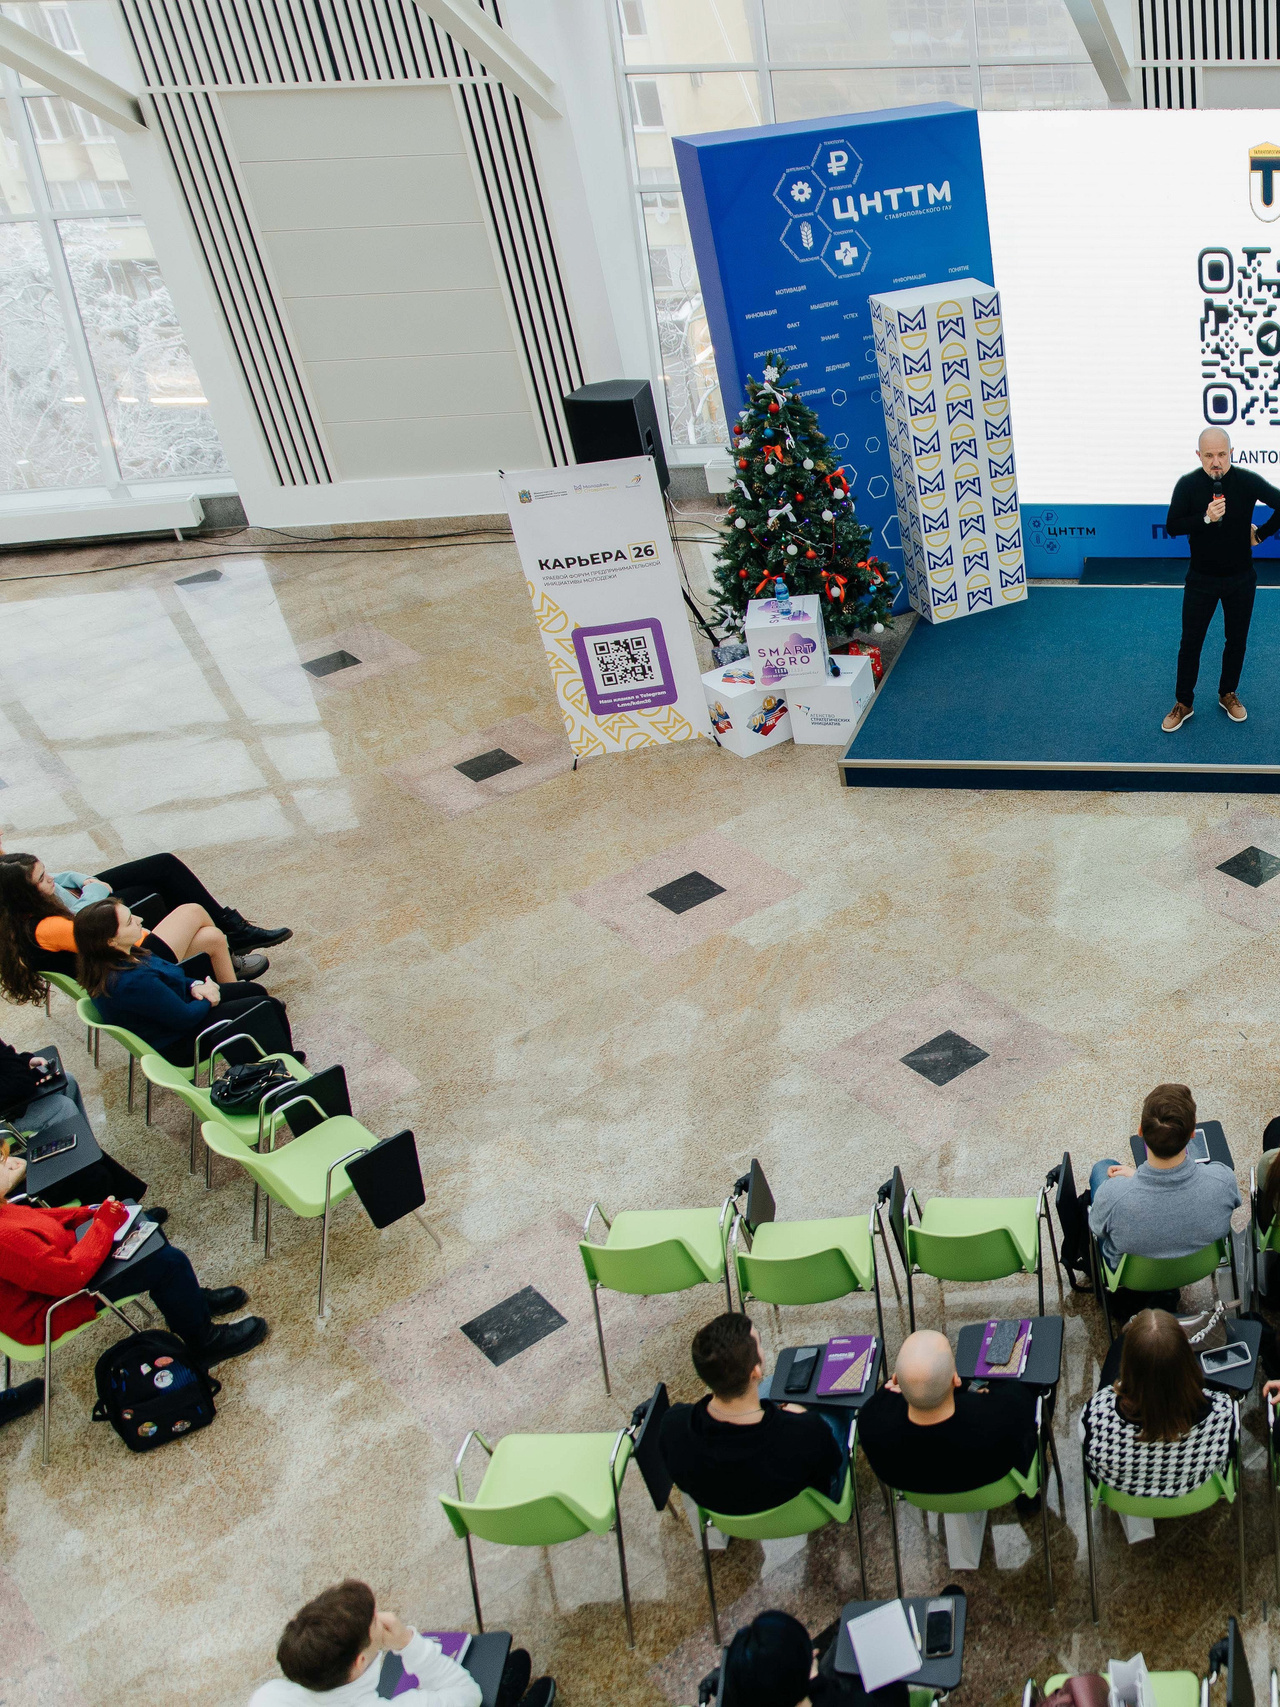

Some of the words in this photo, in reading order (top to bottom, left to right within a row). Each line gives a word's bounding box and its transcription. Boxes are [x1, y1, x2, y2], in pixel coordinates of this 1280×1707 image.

[832, 180, 951, 222] ЦНТТМ
[884, 206, 941, 220] СТАВРОПОЛЬСКОГО
[942, 204, 953, 212] ГАУ
[948, 265, 970, 274] ПОНЯТИЕ
[892, 273, 926, 284] ИНФОРМАЦИЯ
[775, 284, 807, 296] МОТИВАЦИЯ
[810, 300, 839, 310] МЫШЛЕНИЕ
[745, 308, 778, 320] ИННОВАЦИЯ
[842, 312, 858, 320] УСПЕХ
[820, 333, 840, 342] ЗНАНИЕ
[825, 362, 851, 373] ДЕДУКЦИЯ
[858, 372, 880, 382] ГИПОТЕЗ
[1047, 526, 1096, 538] ЦНТТМ
[538, 549, 628, 571] КАРЬЕРА
[632, 544, 655, 559] 26
[542, 573, 568, 581] КРАЕВОЙ
[568, 571, 590, 579] ФОРУМ
[544, 579, 582, 587] ИНИЦИАТИВЫ
[757, 643, 813, 658] SMART
[764, 655, 811, 668] AGRO
[640, 690, 667, 698] Telegram
[752, 714, 766, 730] 90
